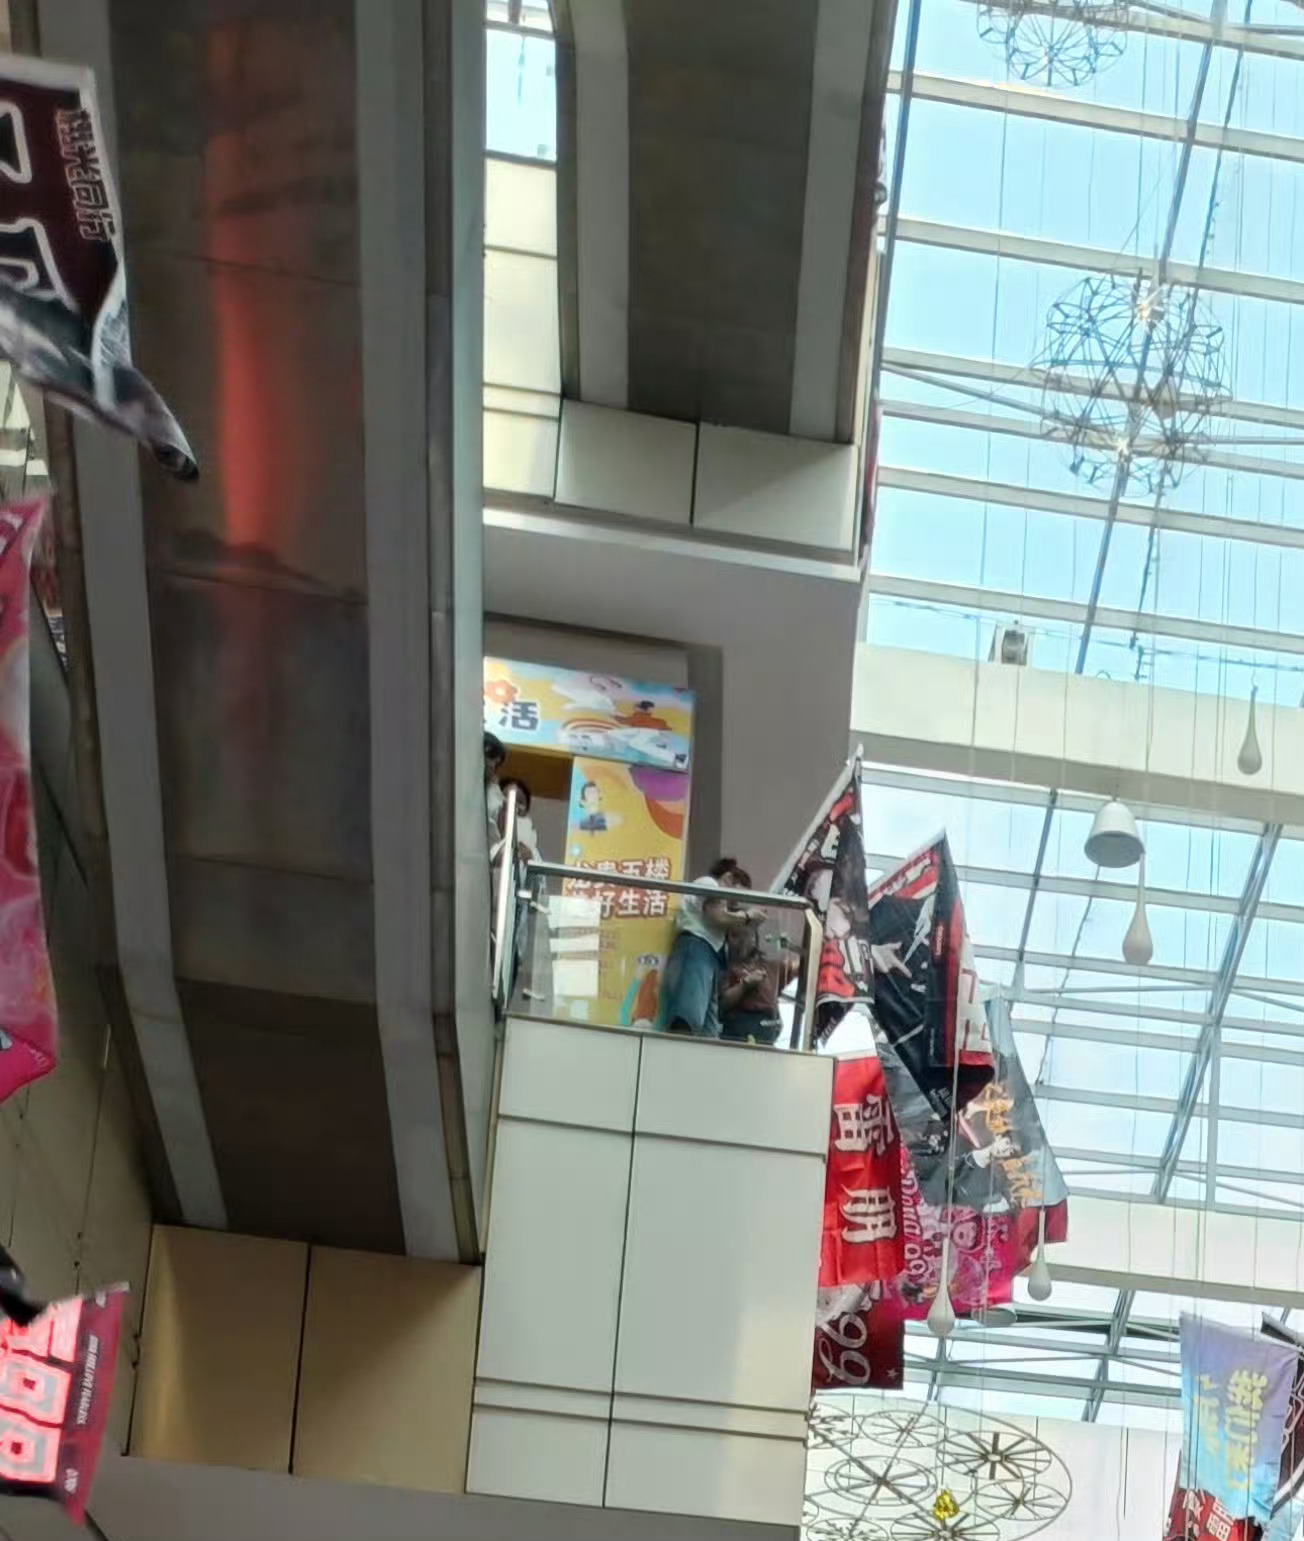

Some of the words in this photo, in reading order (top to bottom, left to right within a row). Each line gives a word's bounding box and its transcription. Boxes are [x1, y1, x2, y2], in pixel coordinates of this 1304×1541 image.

[501, 700, 540, 731] 活
[572, 888, 670, 918] 好生活
